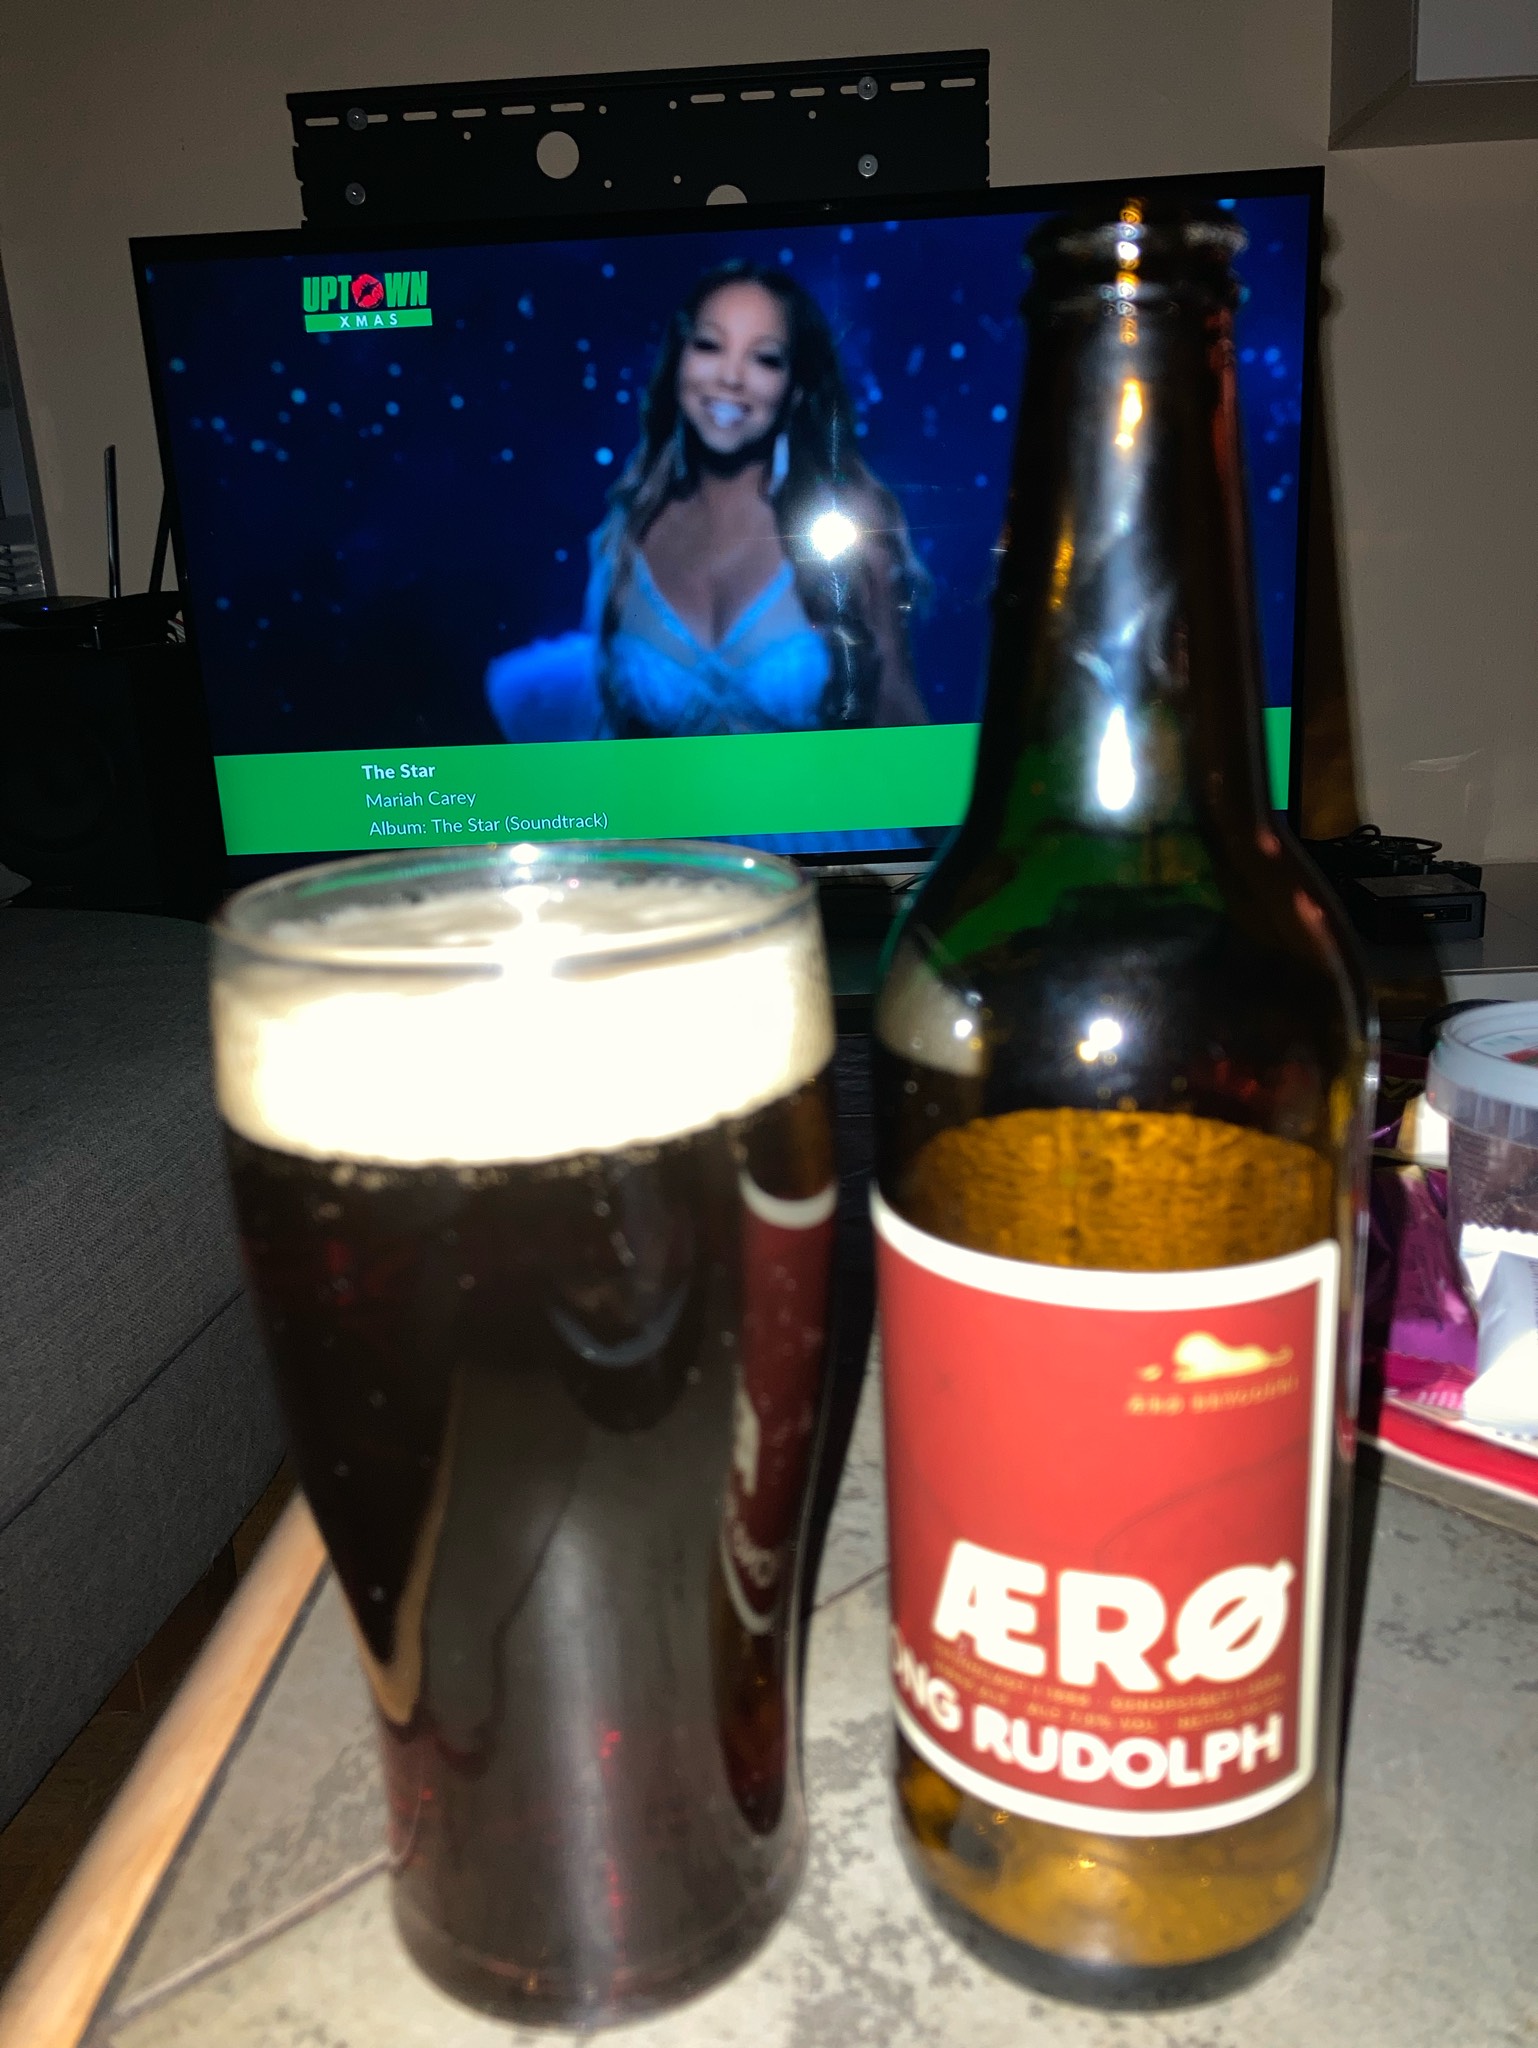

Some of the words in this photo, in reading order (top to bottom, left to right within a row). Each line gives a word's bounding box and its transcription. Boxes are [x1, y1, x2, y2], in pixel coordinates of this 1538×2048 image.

[303, 271, 428, 312] UPTOWN
[340, 313, 398, 328] XMAS
[361, 764, 395, 779] The
[400, 763, 435, 778] Star
[365, 791, 423, 808] Mariah
[428, 790, 476, 807] Carey
[369, 821, 427, 836] Album:
[431, 818, 463, 834] The
[467, 816, 500, 832] Star
[504, 812, 608, 833] (Soundtrack)
[932, 1538, 1295, 1693] ÆRØ
[972, 1703, 1284, 1790] RUDOLPH
